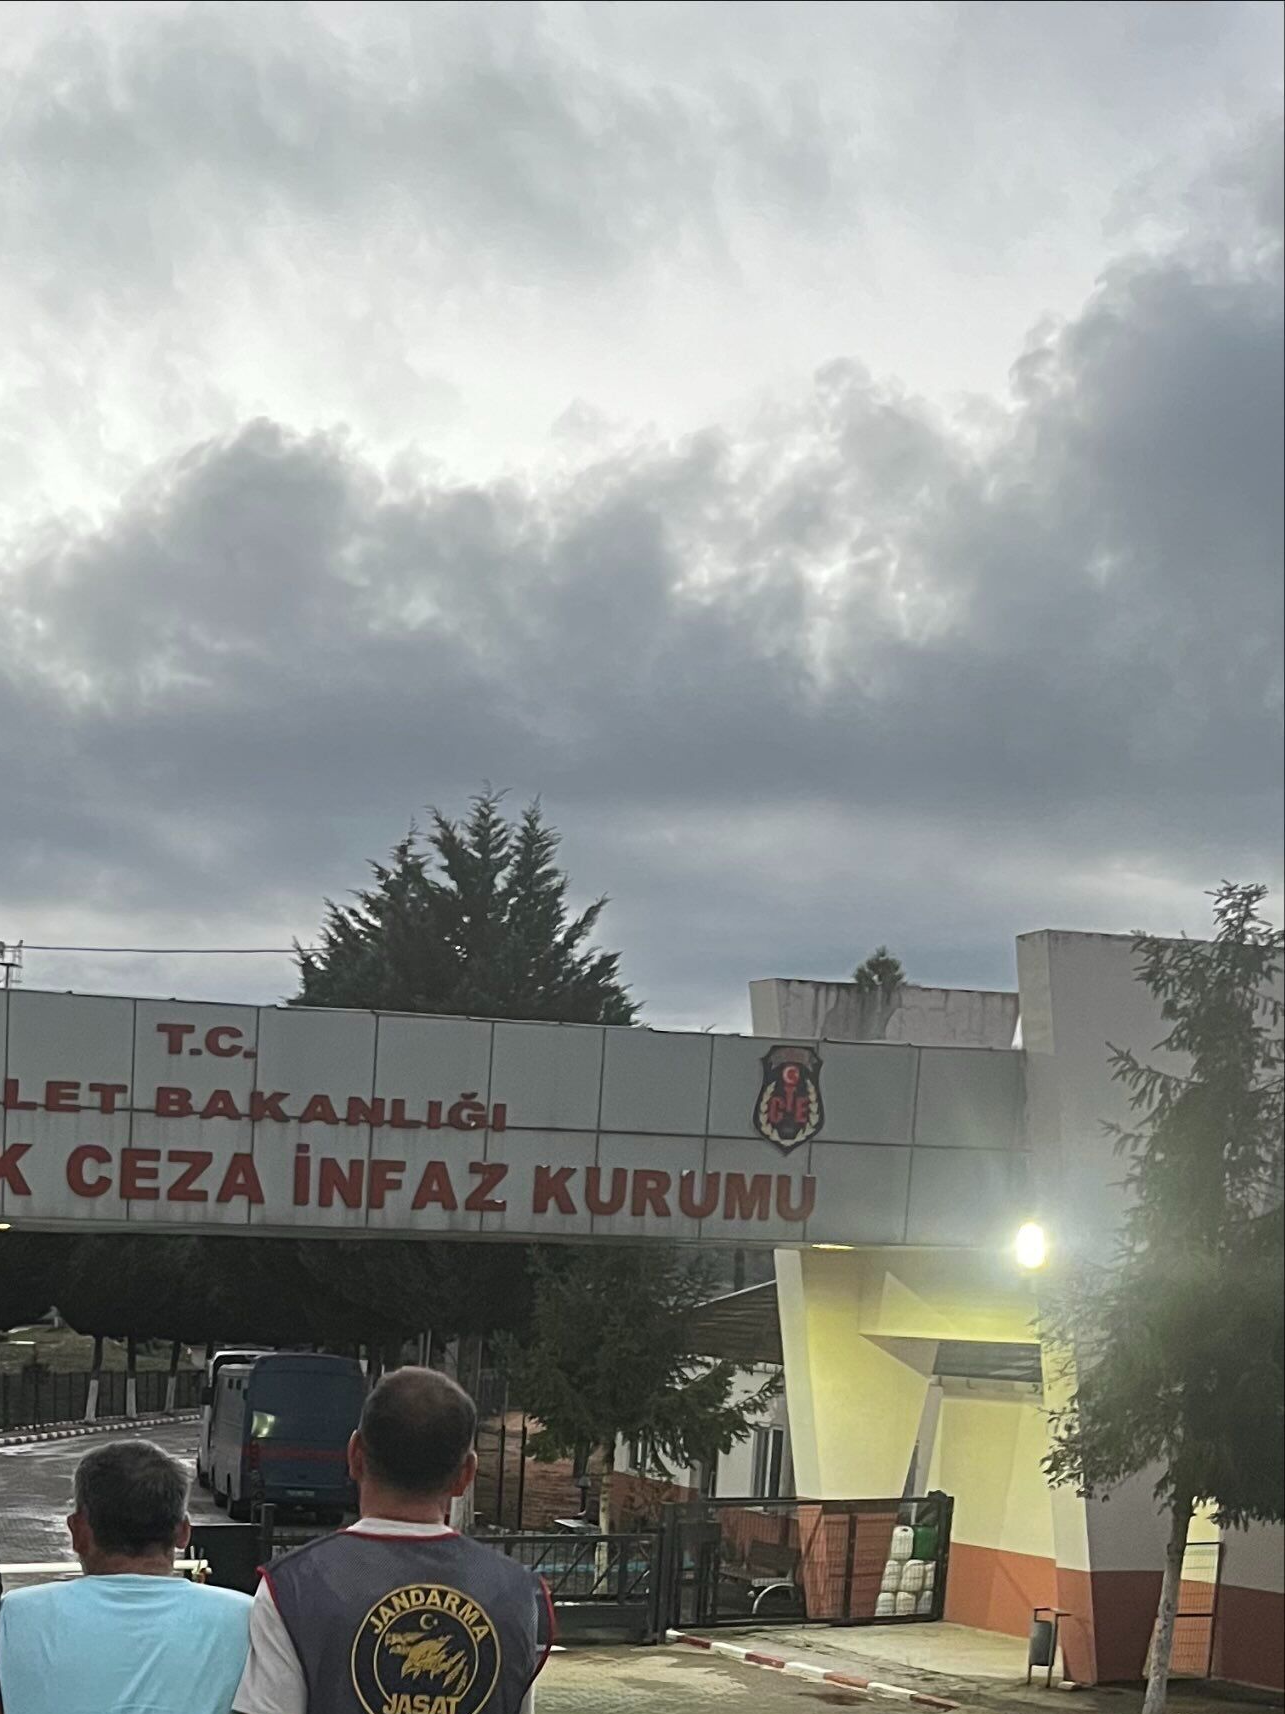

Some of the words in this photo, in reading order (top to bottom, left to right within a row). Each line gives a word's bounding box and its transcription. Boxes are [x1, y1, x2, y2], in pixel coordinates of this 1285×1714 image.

[156, 1022, 257, 1059] T.C.
[154, 1085, 508, 1132] BAKANLIĞI
[66, 1144, 266, 1205] CEZA
[293, 1142, 510, 1213] İNFAZ
[531, 1163, 817, 1222] KURUMU
[369, 1587, 491, 1644] JANDARMA
